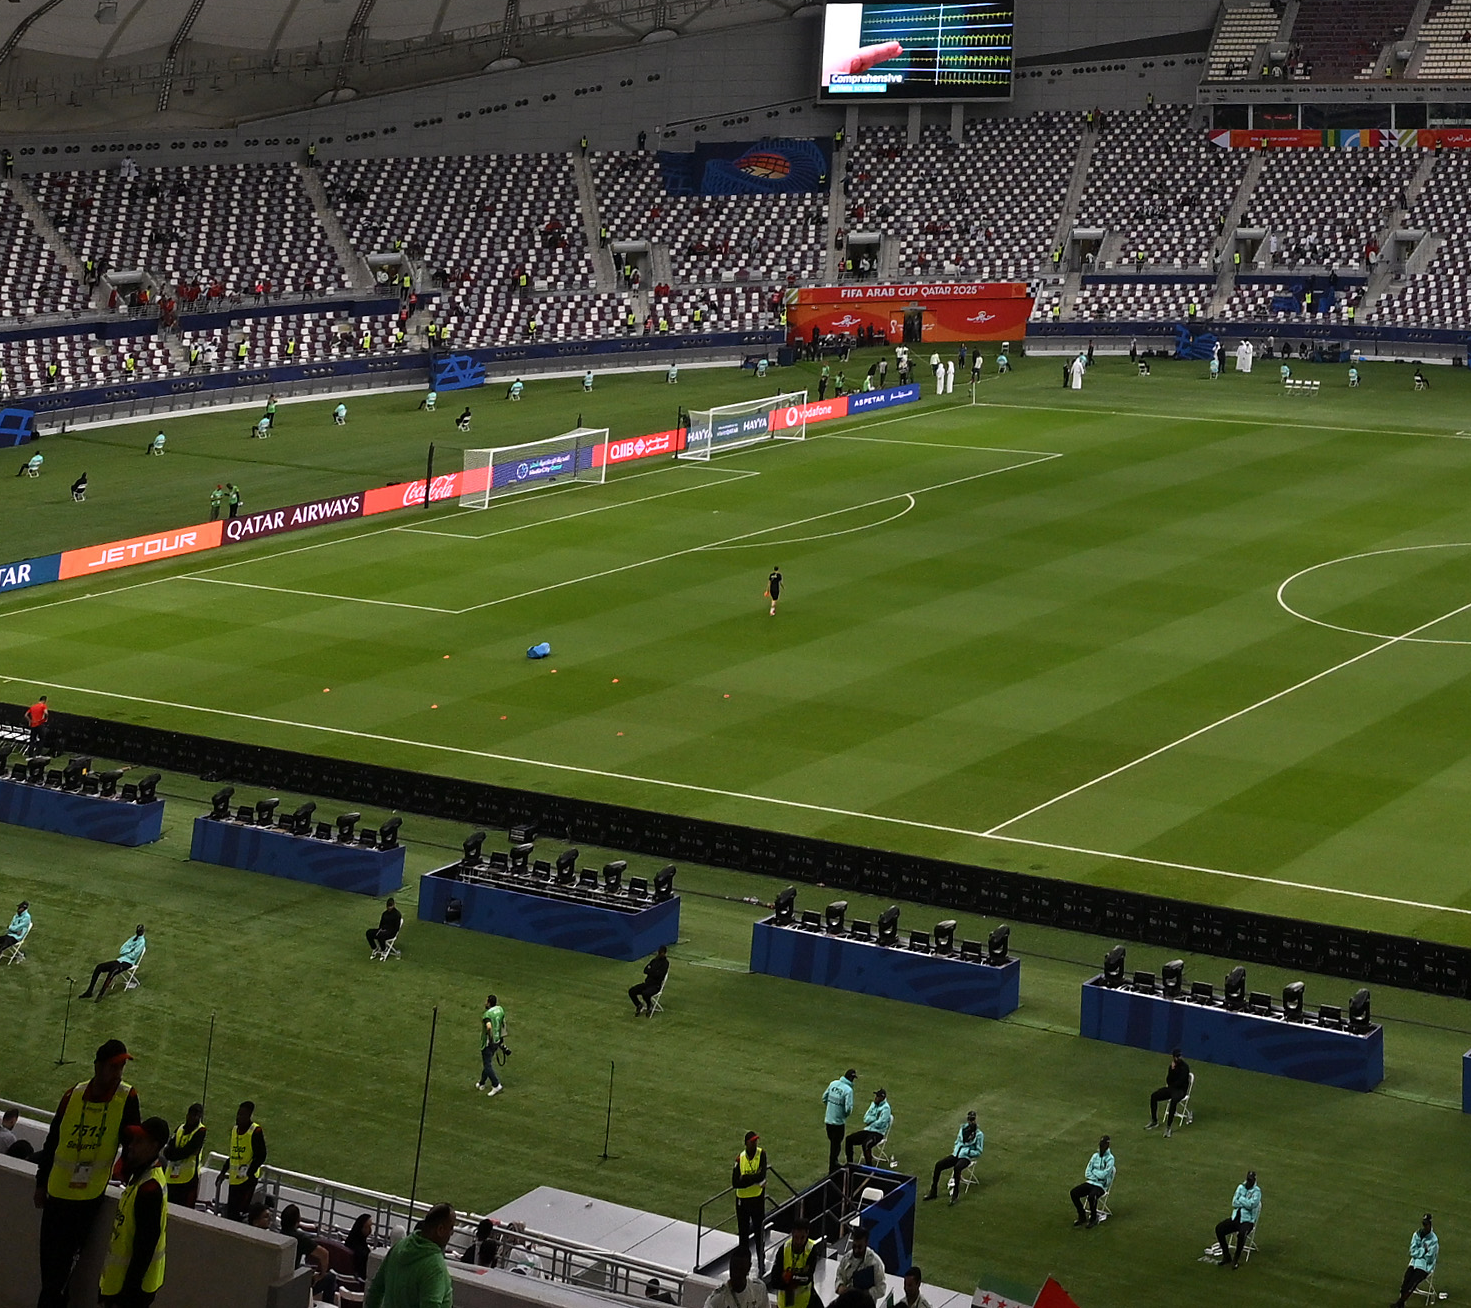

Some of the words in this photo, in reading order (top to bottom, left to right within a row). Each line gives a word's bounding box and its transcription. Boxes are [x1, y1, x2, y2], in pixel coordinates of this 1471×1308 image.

[831, 73, 903, 84] Comprehensive
[841, 288, 864, 298] FIFA
[865, 287, 896, 298] ARAB
[898, 287, 919, 296] CUP
[920, 286, 951, 297] QATAR
[854, 394, 885, 408] ASPETAR
[799, 403, 833, 419] vodafone
[743, 417, 768, 431] HAYYA
[610, 441, 634, 459] QIIB
[402, 474, 458, 507] CocaCola
[227, 511, 285, 541] QATAR
[290, 496, 361, 526] AIRWAYS
[88, 532, 198, 567] JETOUR
